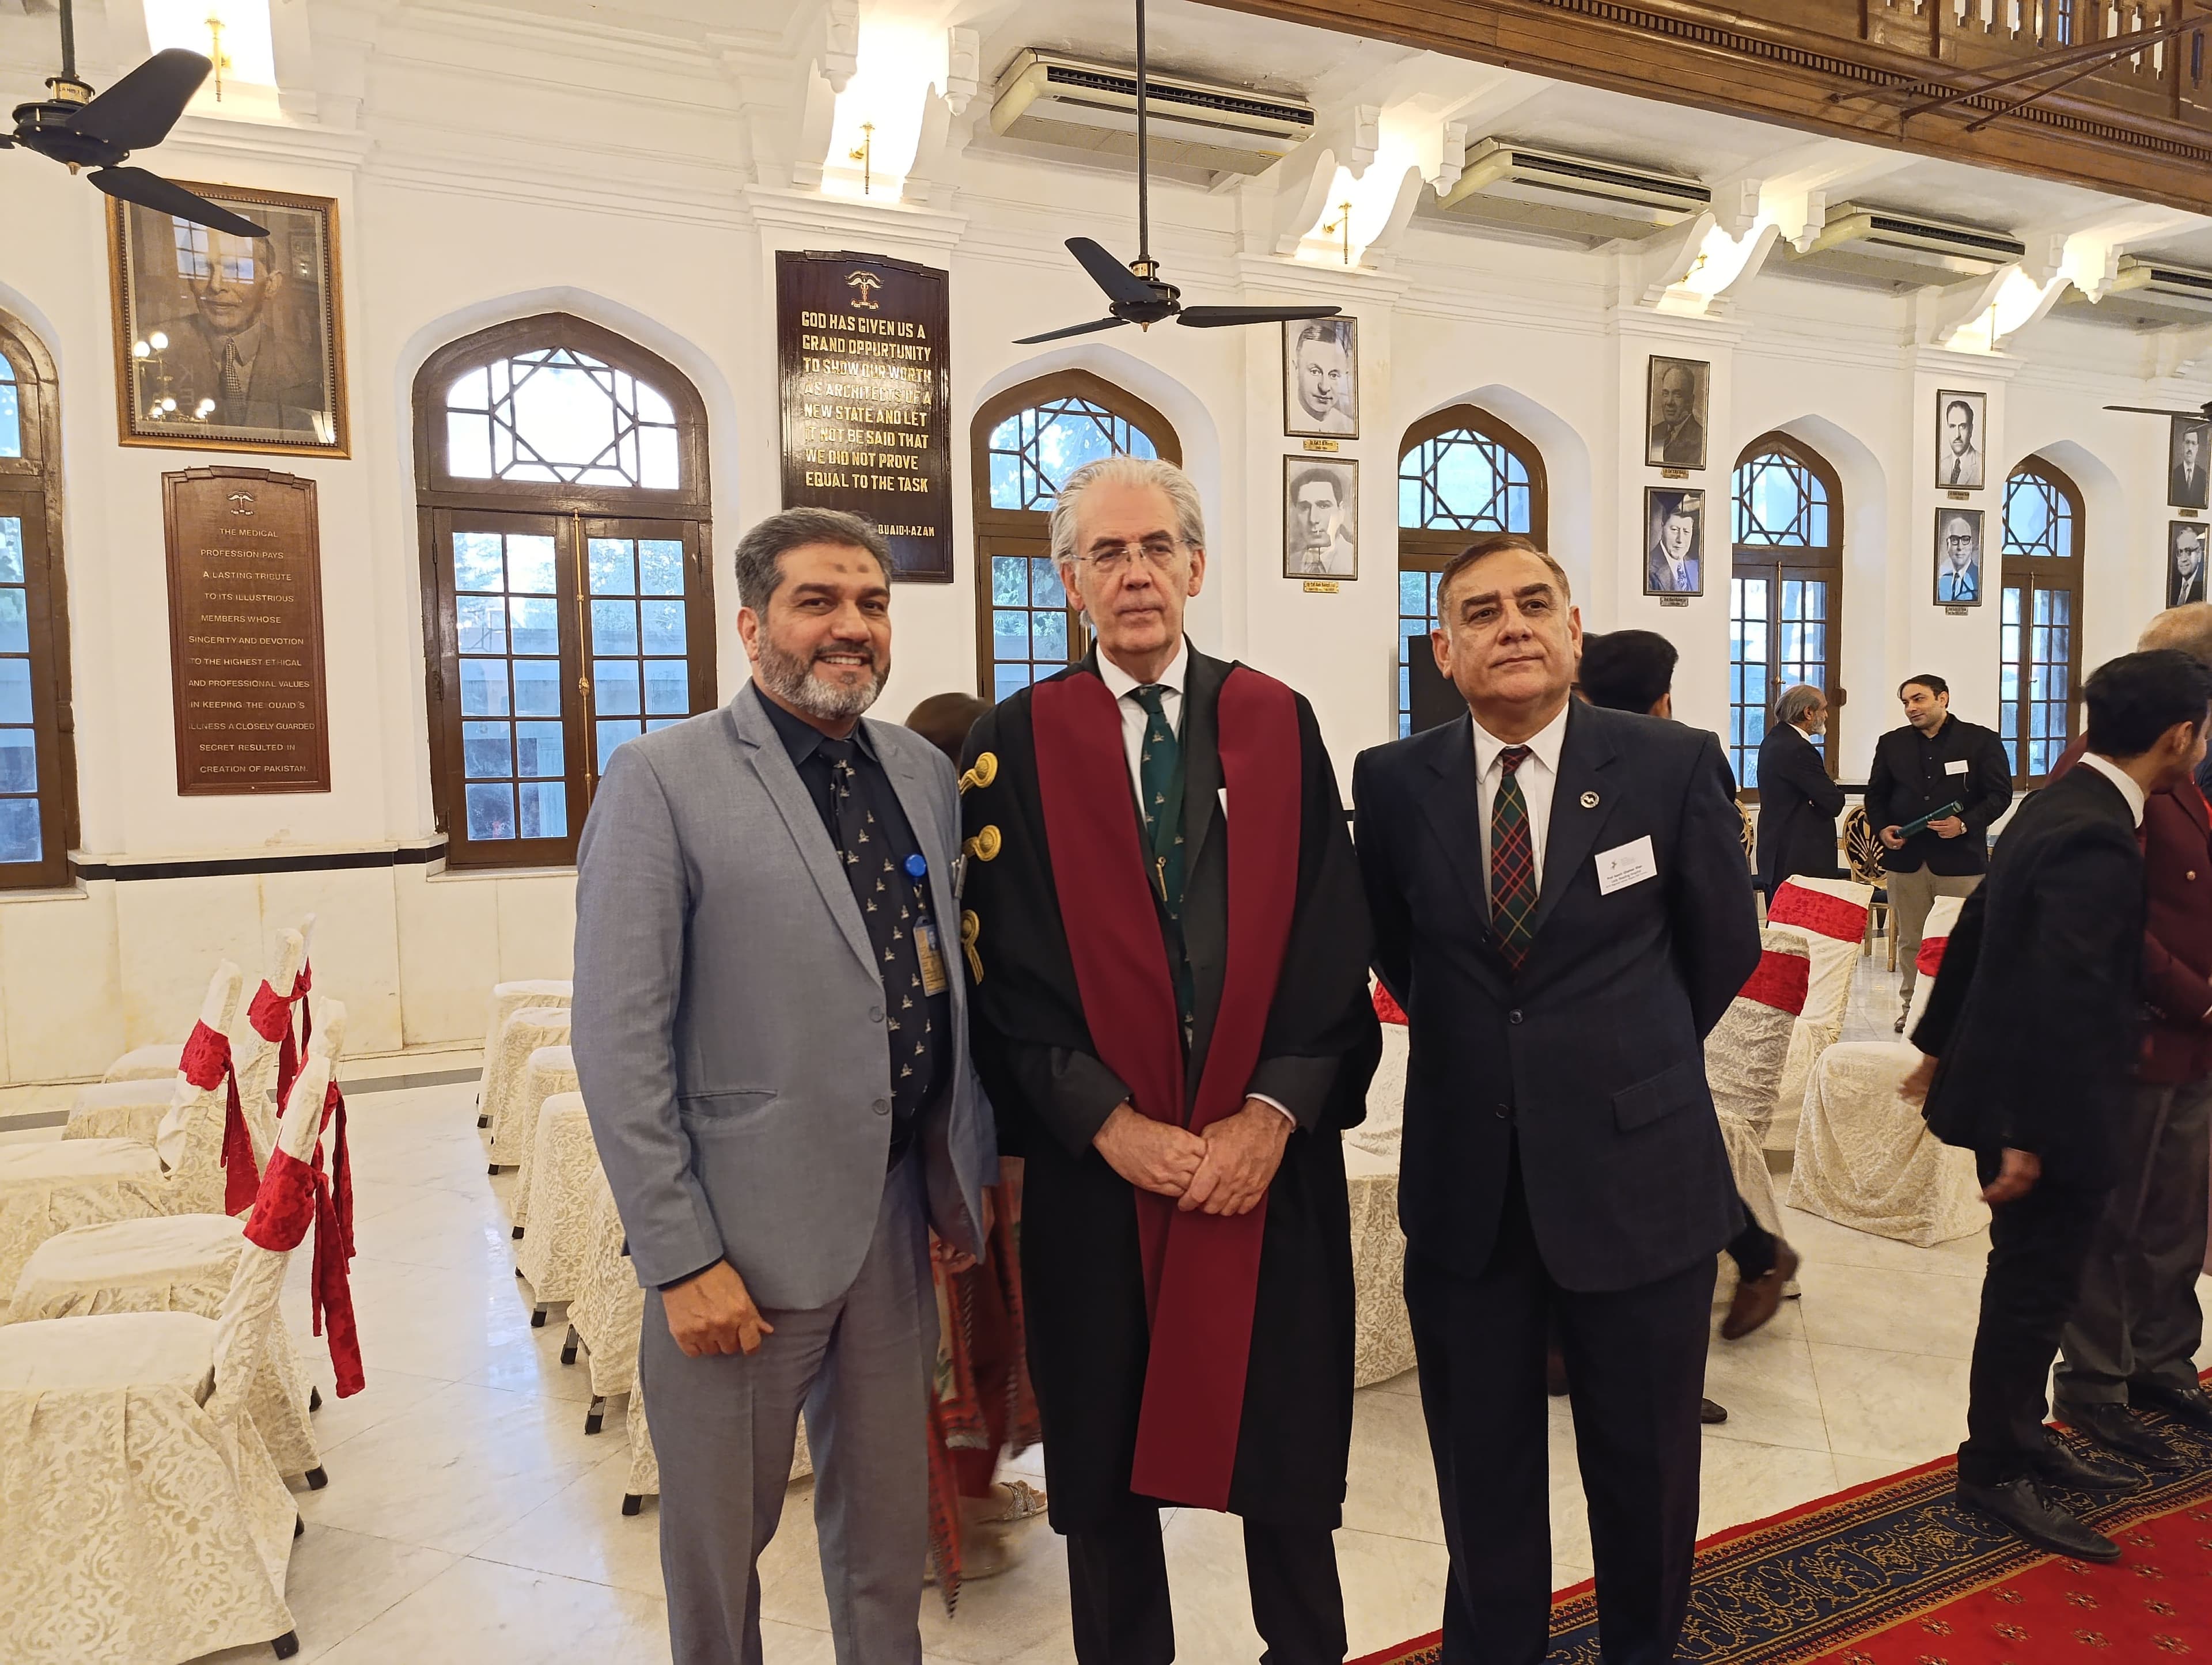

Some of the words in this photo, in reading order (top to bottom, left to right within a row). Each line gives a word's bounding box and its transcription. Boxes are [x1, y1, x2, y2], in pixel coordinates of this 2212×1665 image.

[802, 311, 826, 329] GOD
[830, 314, 855, 331] HAS
[858, 317, 894, 336] GIVEN
[897, 322, 913, 337] US
[917, 324, 926, 339] A
[802, 335, 845, 353] GRAND
[849, 339, 931, 361] OPPURTUNITY
[803, 357, 819, 372] TO
[823, 358, 858, 376] SHOW
[862, 363, 885, 378] OUR
[888, 365, 931, 383] WORTH
[804, 382, 822, 396] AS
[825, 384, 905, 402] ARCHITECTS
[906, 388, 920, 404] OF
[924, 390, 931, 404] A
[805, 404, 832, 418] NEW
[835, 406, 873, 423] STATE
[876, 409, 902, 424] AND
[904, 412, 926, 427] LET
[805, 427, 817, 441] IT
[820, 427, 844, 443] NOT
[848, 430, 864, 444] BE
[866, 431, 895, 446] SAID
[898, 433, 929, 449] THAT
[806, 449, 825, 464] WE
[829, 450, 849, 466] DID
[853, 452, 876, 467] NOT
[879, 453, 918, 470] PROVE
[806, 471, 849, 487] EQUAL
[853, 474, 868, 488] TO
[871, 475, 894, 491] THE
[897, 476, 928, 492] TASK
[240, 529, 278, 538] MEDICAL
[201, 549, 258, 558] PROFESSION
[189, 636, 237, 644] SINCERITY
